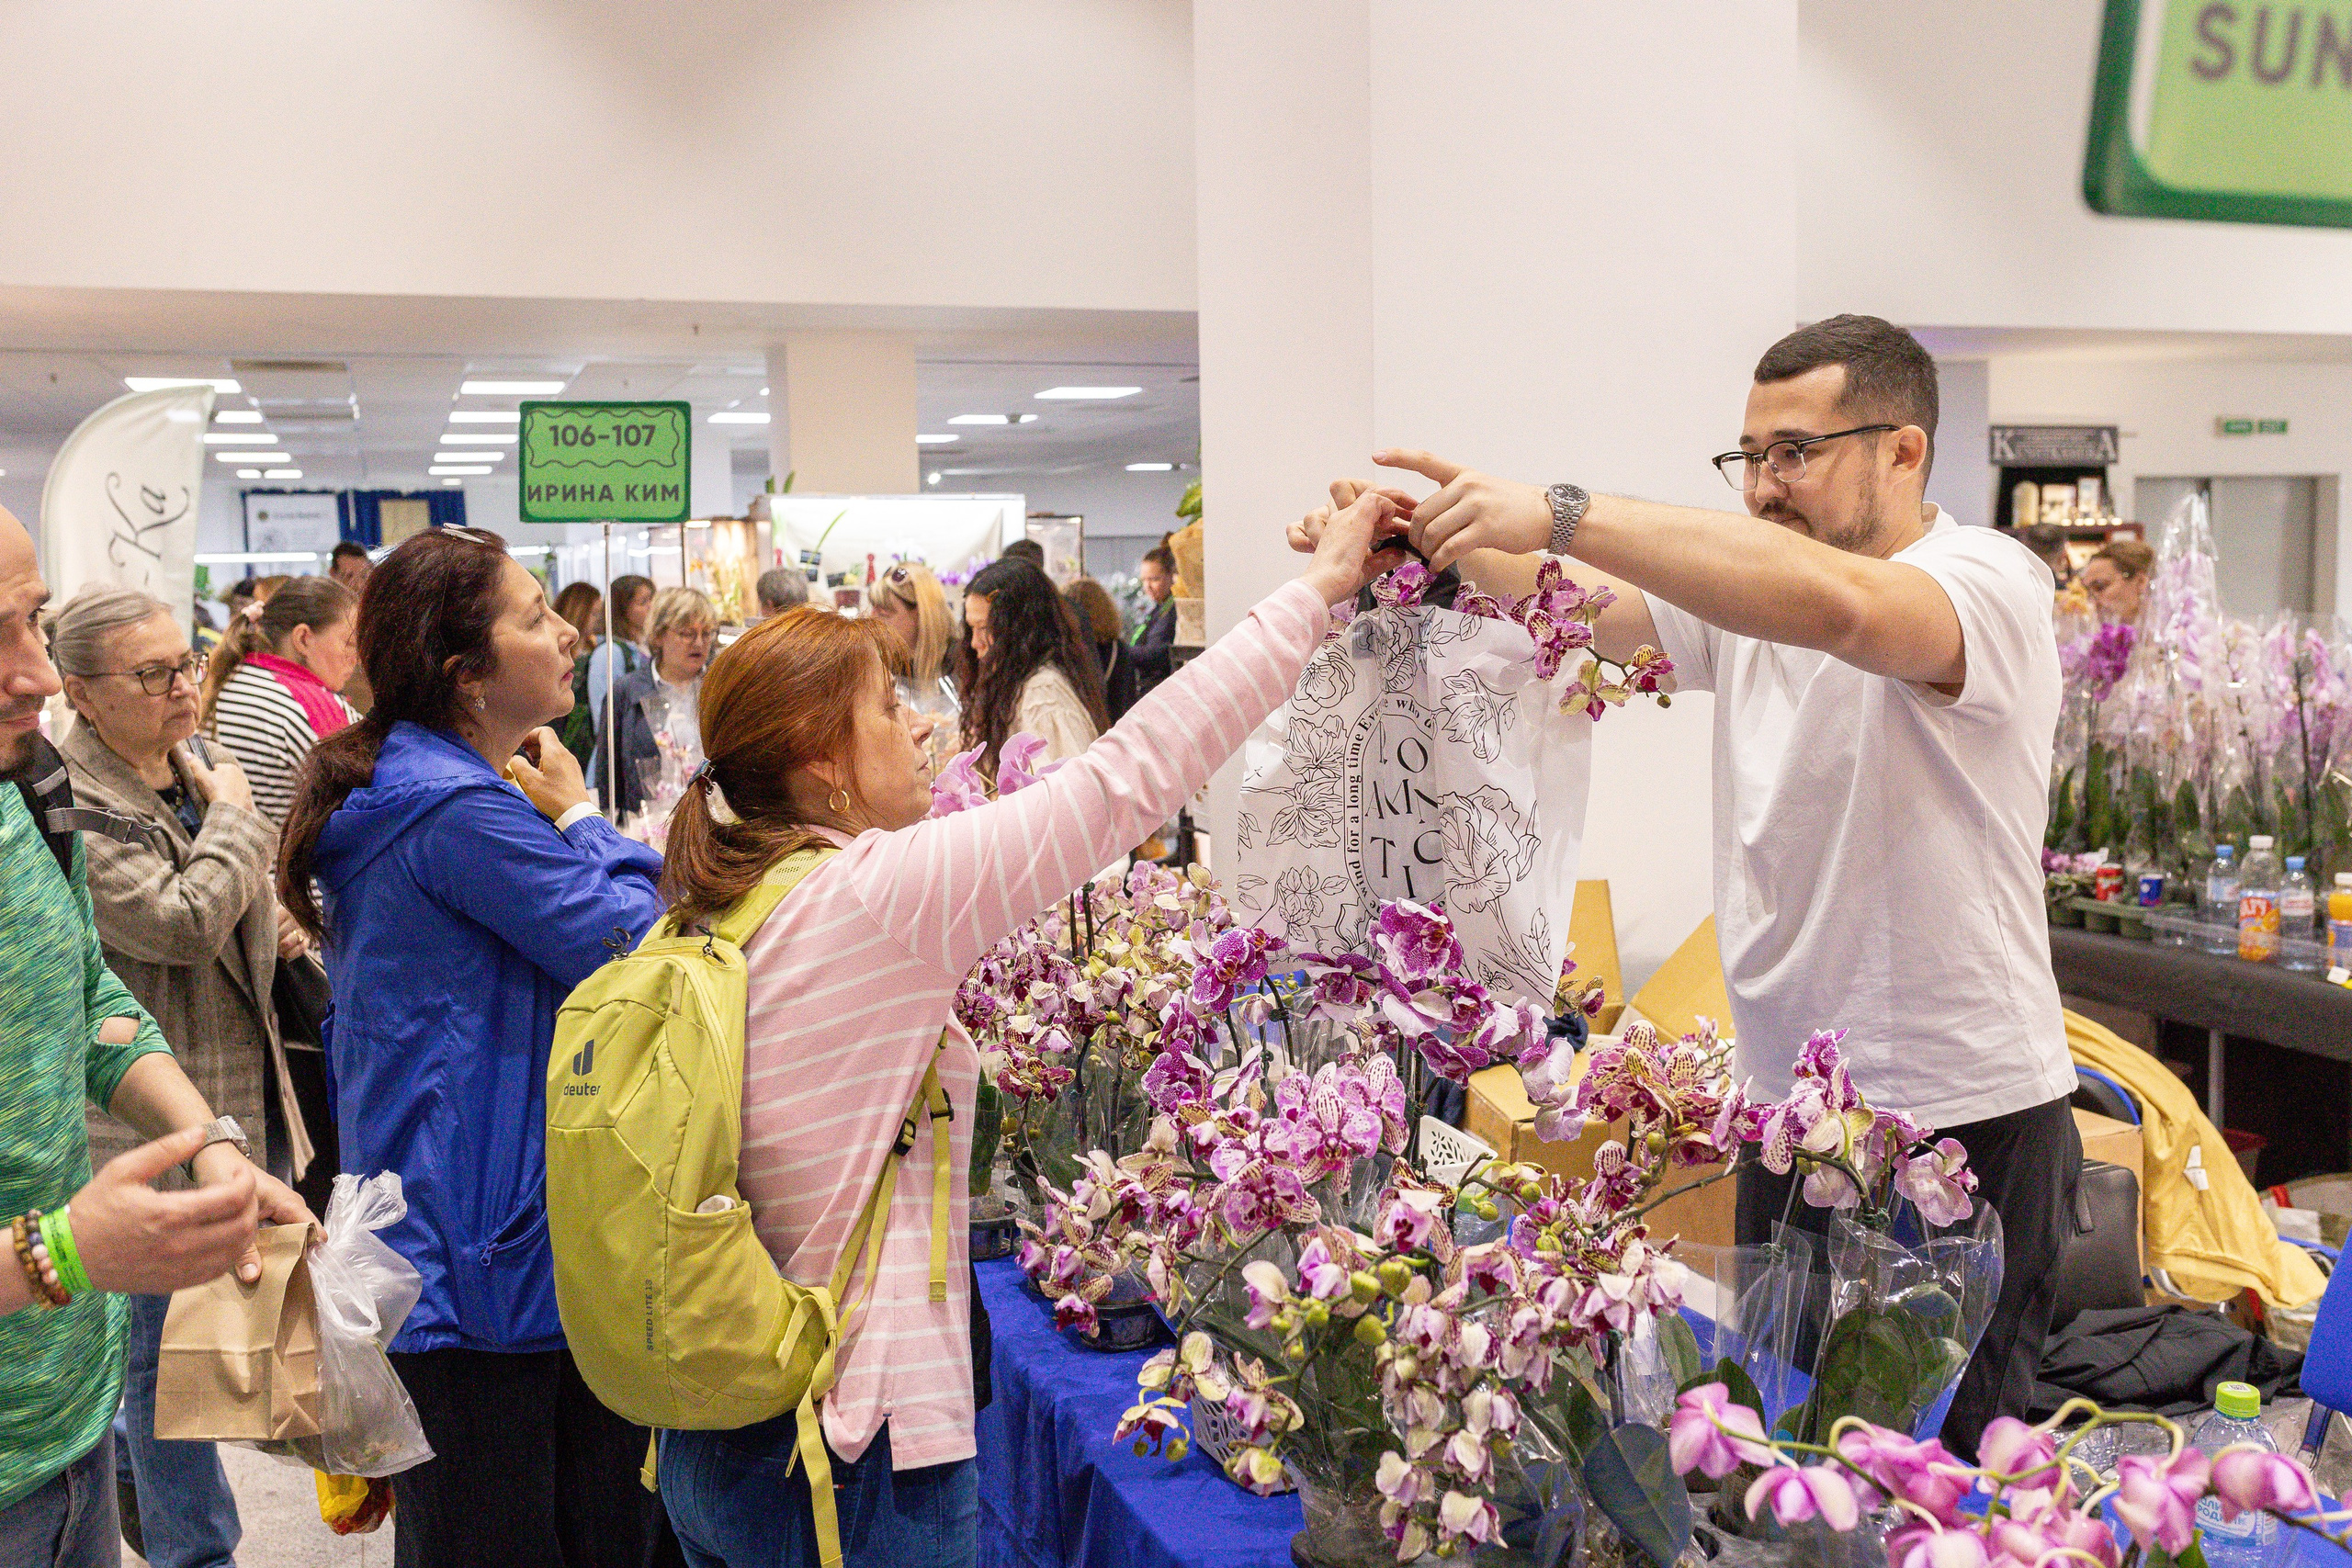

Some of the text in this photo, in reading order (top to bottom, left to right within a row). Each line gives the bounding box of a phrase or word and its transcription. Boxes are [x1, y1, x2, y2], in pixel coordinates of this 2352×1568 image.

[548, 425, 656, 447] 106-107
[527, 484, 679, 502] ИРИНА КИМ
[1396, 699, 1420, 718] who
[1346, 733, 1368, 897] wind for a long time
[563, 1082, 601, 1096] deuter
[645, 1293, 654, 1315] LITE
[645, 1318, 655, 1351] SPEED
